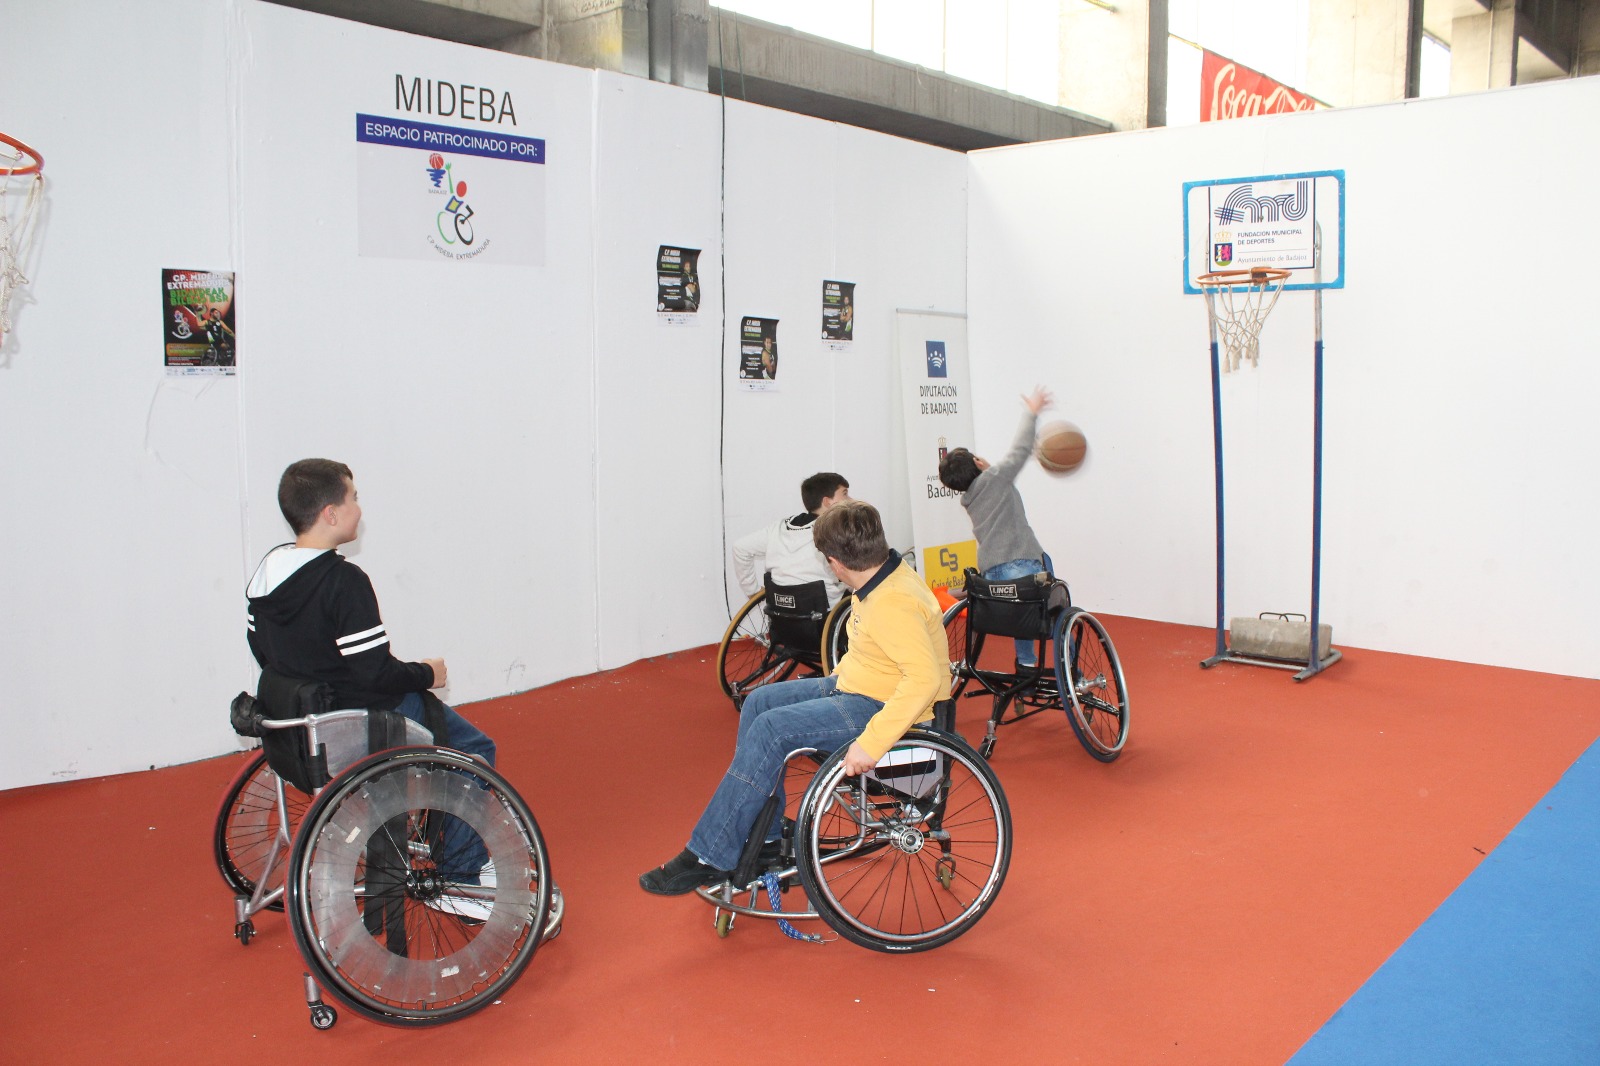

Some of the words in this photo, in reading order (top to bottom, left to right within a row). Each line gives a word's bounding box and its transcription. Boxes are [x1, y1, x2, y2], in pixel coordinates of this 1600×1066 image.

[395, 74, 517, 126] MIDEBA
[365, 122, 420, 141] ESPACIO
[423, 130, 507, 153] PATROCINADO
[510, 142, 538, 157] POR:
[456, 238, 491, 260] EXTREMADURA
[1237, 255, 1276, 264] Ayuntamiento
[1285, 254, 1307, 263] Badajoz
[920, 383, 957, 397] DIPUTACIÓN
[921, 403, 929, 415] DE
[931, 402, 957, 416] BADAJOZ
[927, 483, 964, 499] Badajo
[993, 586, 1014, 594] LINCE
[776, 595, 793, 604] LINCE
